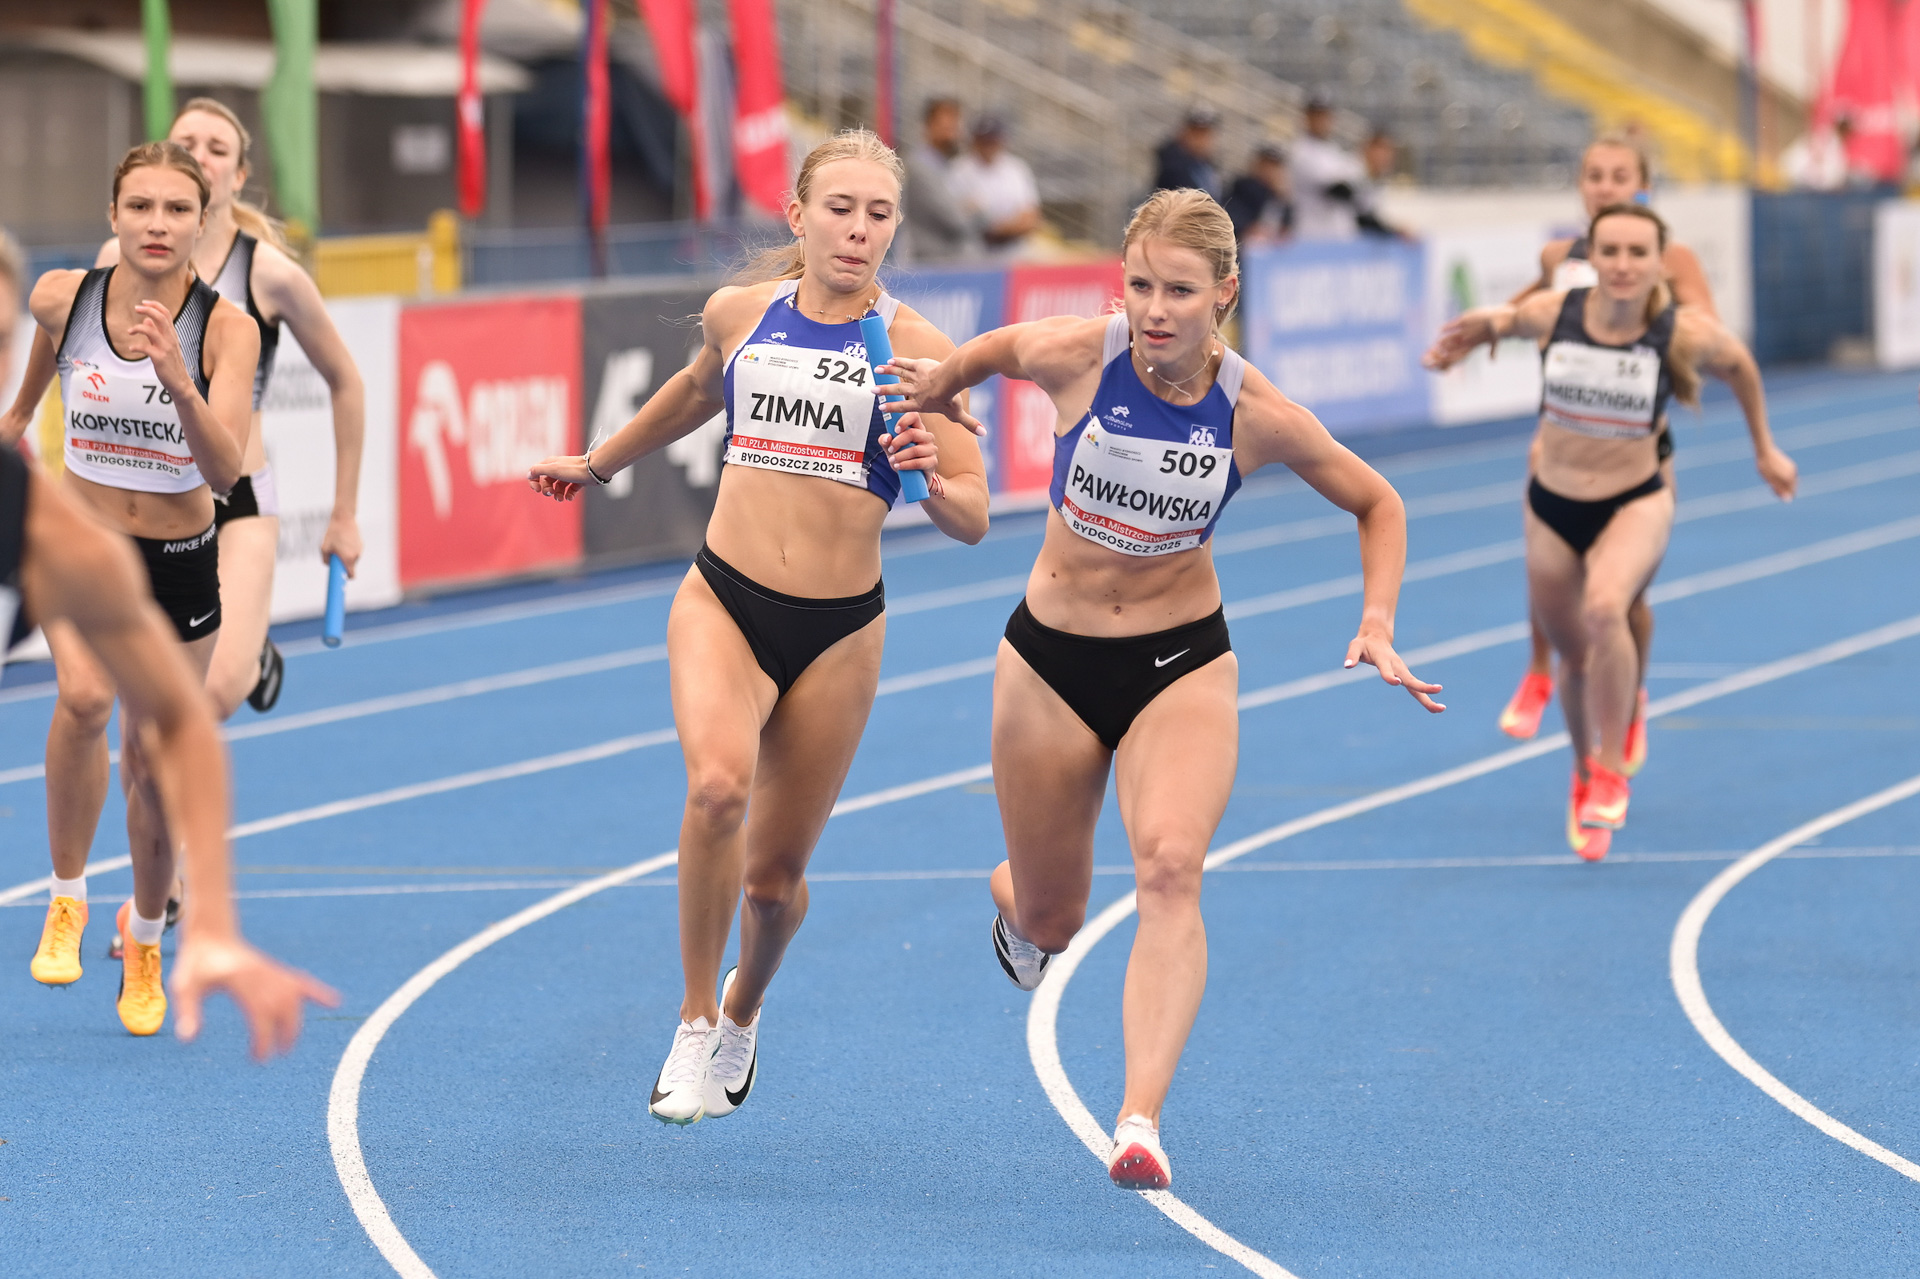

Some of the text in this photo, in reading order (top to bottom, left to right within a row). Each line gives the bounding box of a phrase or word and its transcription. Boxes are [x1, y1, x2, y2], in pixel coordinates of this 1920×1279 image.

[813, 357, 867, 387] 524
[82, 390, 110, 403] ORLEN
[71, 410, 187, 445] KOPYSTECKA
[750, 392, 845, 433] ZIMNA
[93, 442, 114, 453] PZLA
[114, 445, 164, 461] Mistrzostwa
[165, 454, 191, 466] Polski
[737, 437, 856, 461] 101. PZLA Mistrzostwa Polski
[741, 452, 843, 474] BYDGOSZCZ 2025
[1159, 449, 1217, 479] 509
[86, 453, 181, 476] BYDGOSZCZ 2025
[1072, 464, 1211, 522] PAWŁOWSKA
[1069, 502, 1197, 544] 101. PZLA Mistrzostwa Polski
[1073, 519, 1182, 554] BYDGOSZCZ 2025
[163, 538, 200, 553] NIKE
